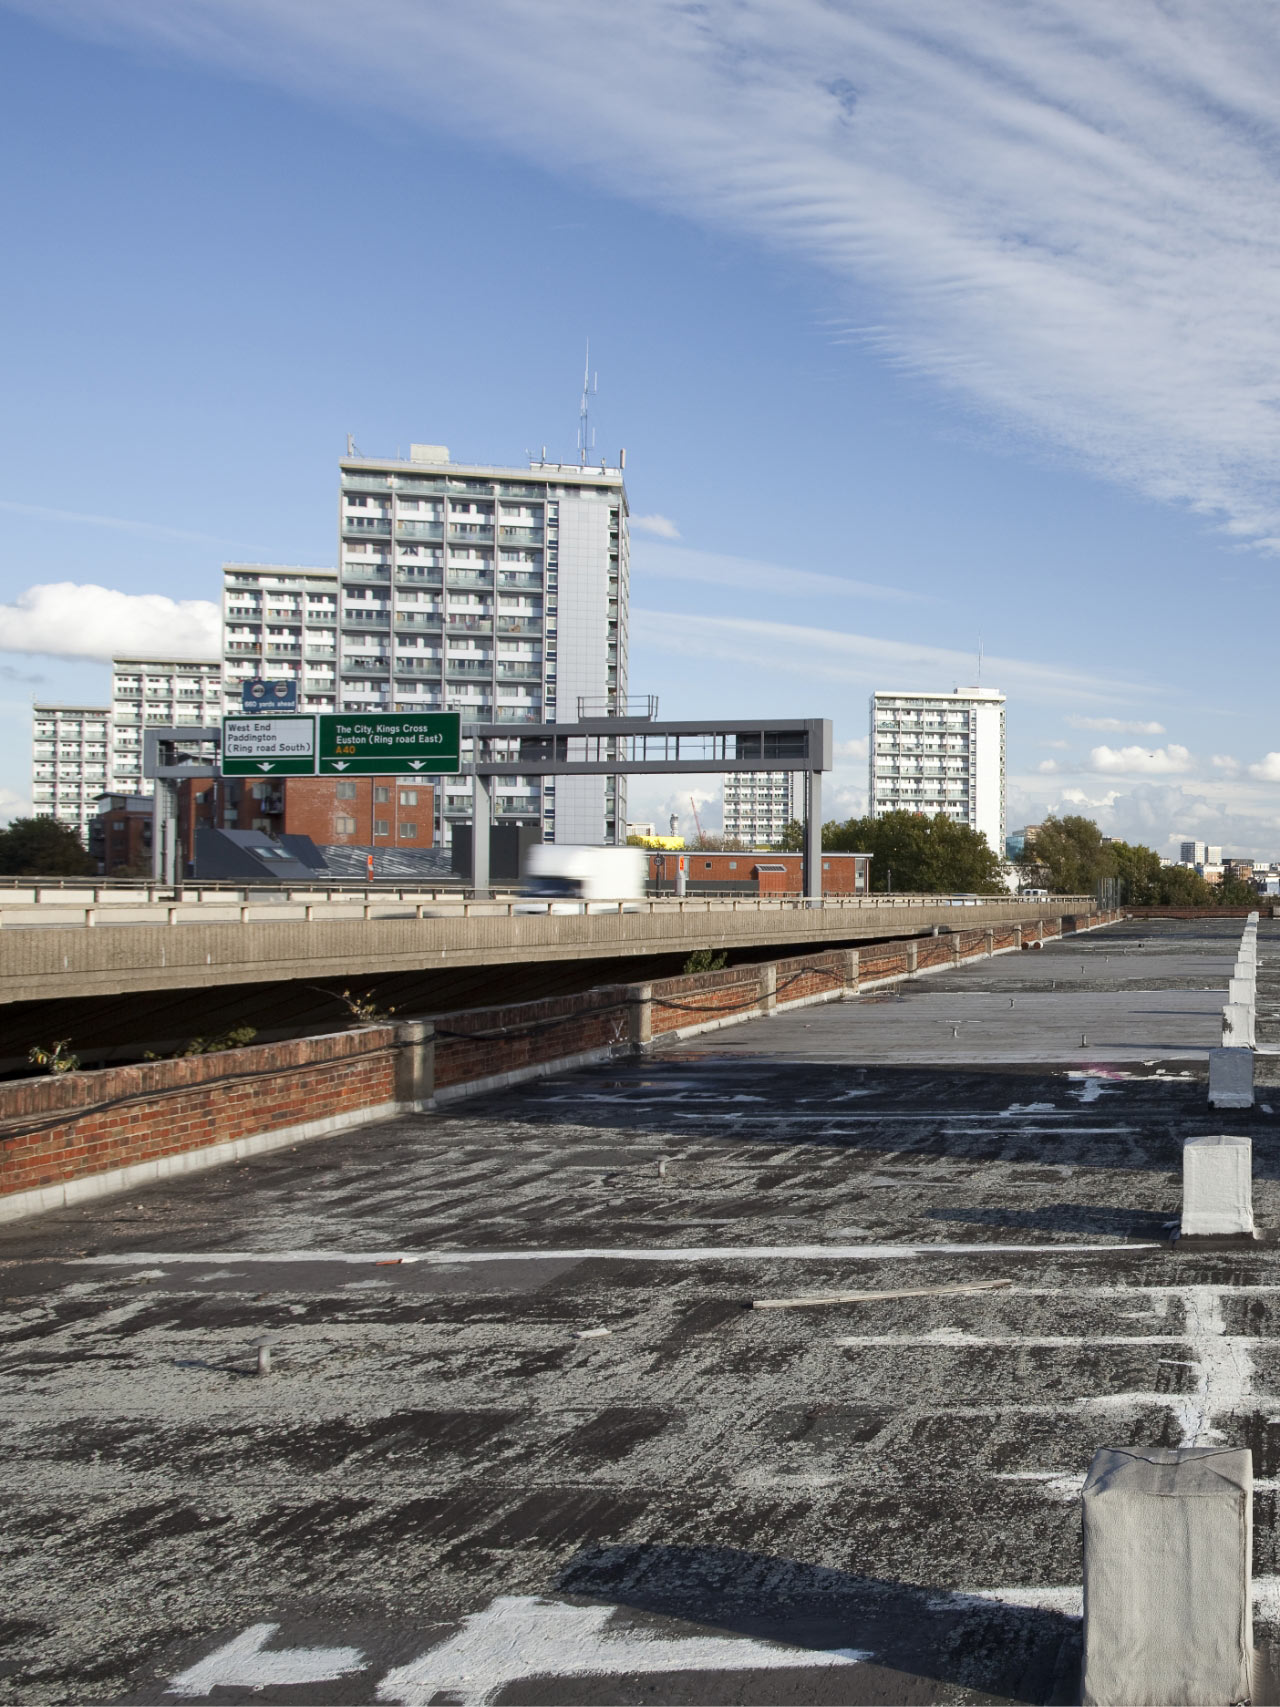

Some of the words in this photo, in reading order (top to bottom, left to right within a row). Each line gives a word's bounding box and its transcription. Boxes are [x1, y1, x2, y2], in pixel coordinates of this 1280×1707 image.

[254, 723, 271, 731] End
[336, 725, 351, 733] The
[376, 724, 400, 734] Kings
[403, 724, 428, 732] Cross
[228, 734, 277, 742] Paddington
[336, 735, 366, 744] Euston
[368, 734, 393, 744] (Ring
[396, 734, 415, 743] road
[418, 733, 443, 743] East)
[227, 744, 253, 753] (Ring
[279, 742, 311, 752] South)
[336, 745, 356, 754] A40
